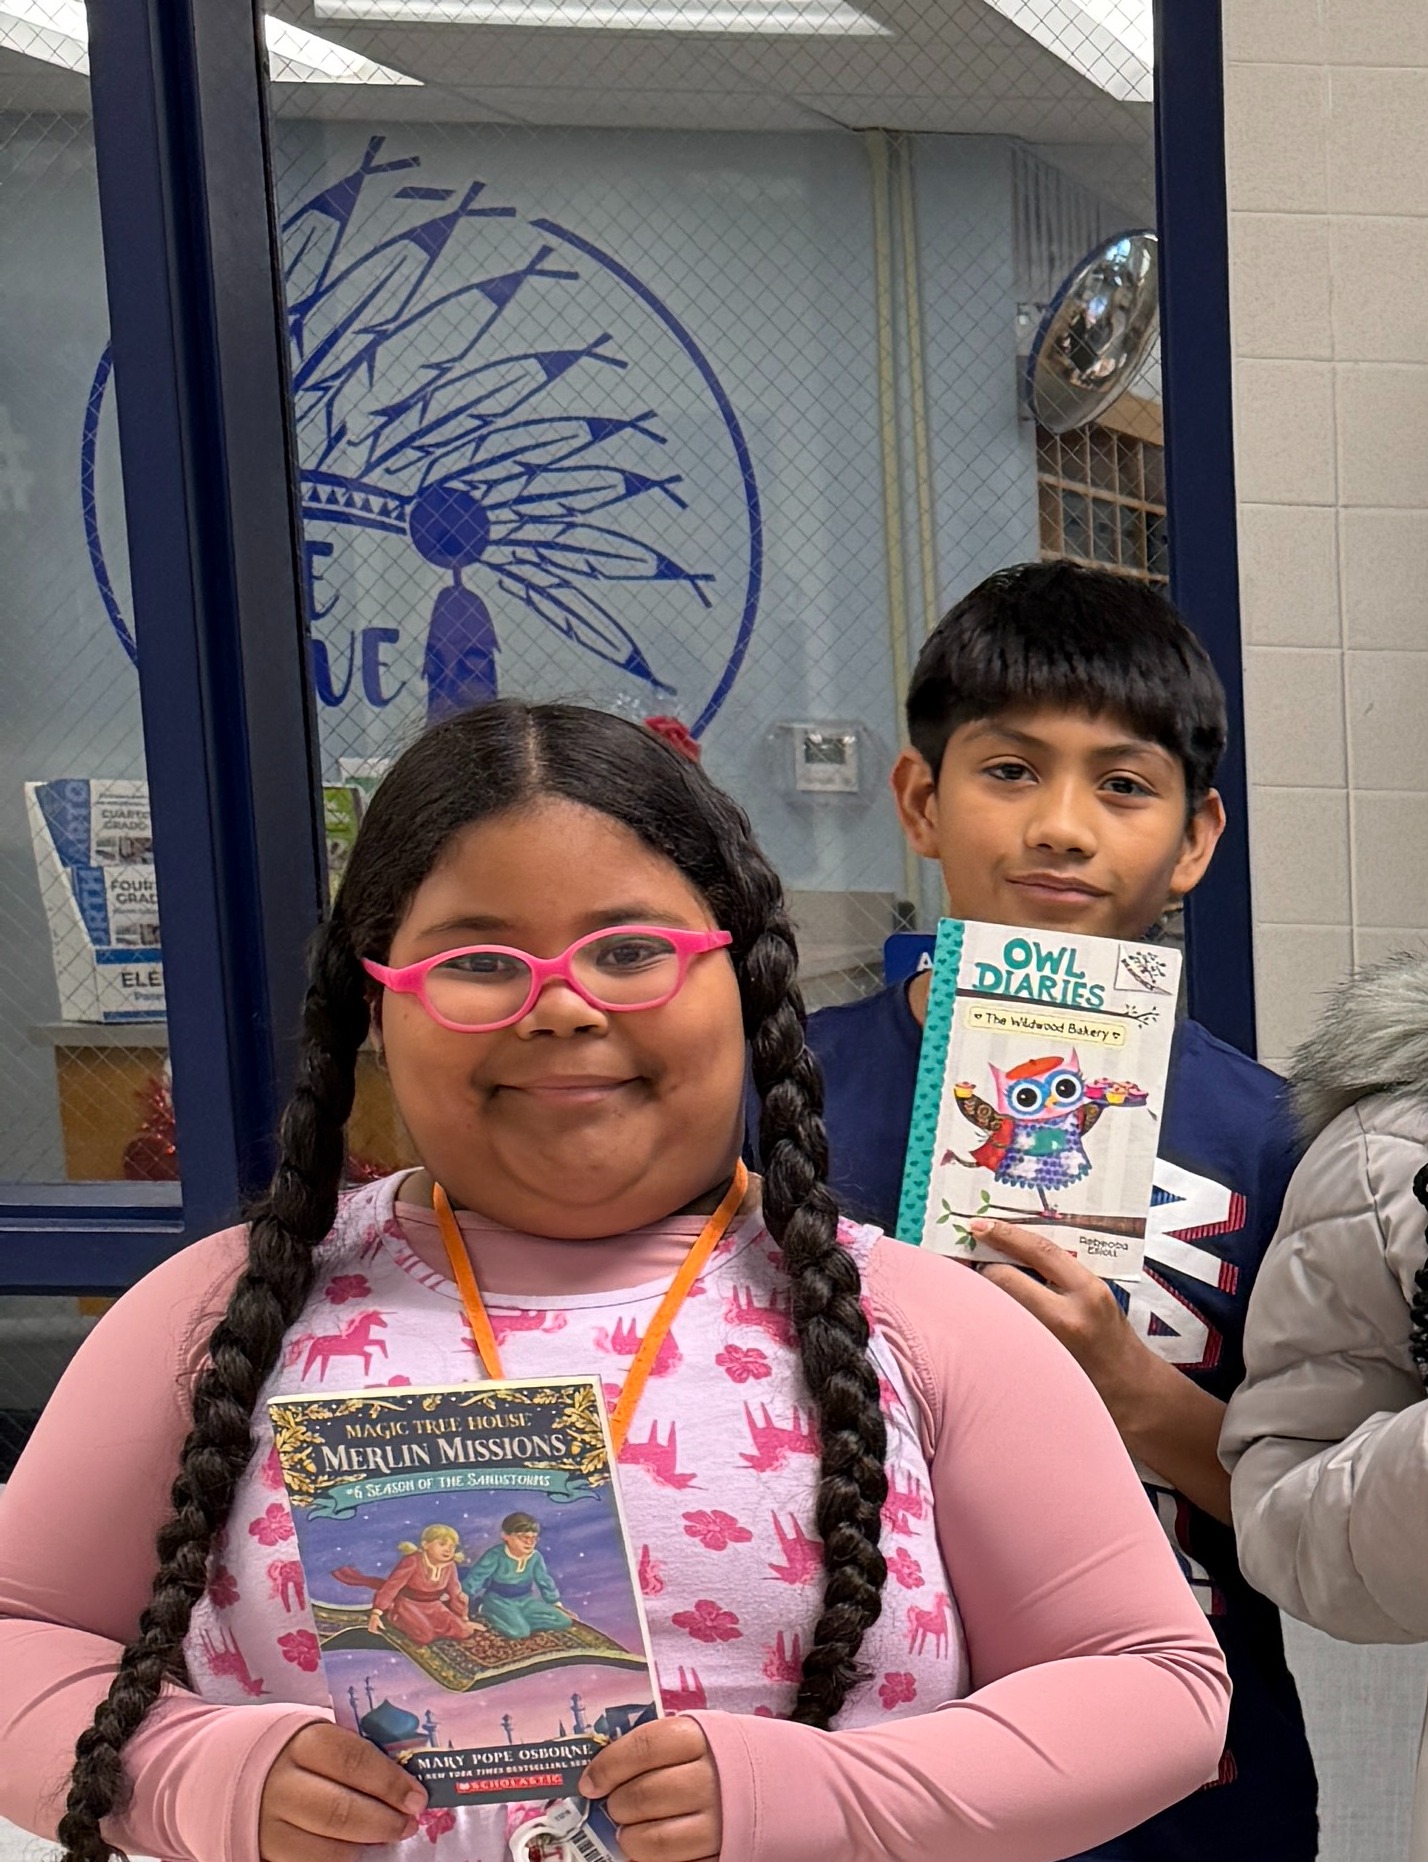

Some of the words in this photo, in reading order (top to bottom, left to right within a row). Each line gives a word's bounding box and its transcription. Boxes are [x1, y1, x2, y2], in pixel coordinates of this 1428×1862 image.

[1003, 937, 1086, 980] OWL
[972, 962, 1106, 1009] DIARIES
[985, 1012, 1006, 1026] The
[1010, 1016, 1064, 1034] Wildwood
[1068, 1022, 1110, 1041] Bakery
[346, 1420, 409, 1441] MAGIC
[412, 1416, 462, 1436] TREE
[467, 1412, 532, 1432] HOUSE
[320, 1441, 431, 1474] MERLIN
[439, 1434, 567, 1464] MISSIONS
[346, 1484, 363, 1498] #6
[365, 1480, 415, 1498] SEASON
[418, 1477, 436, 1490] OF
[440, 1476, 464, 1488] THE
[467, 1472, 550, 1488] SANDSTORMS
[418, 1755, 466, 1769] MARY
[472, 1751, 514, 1765] POPE
[519, 1744, 593, 1760] OSBORNE
